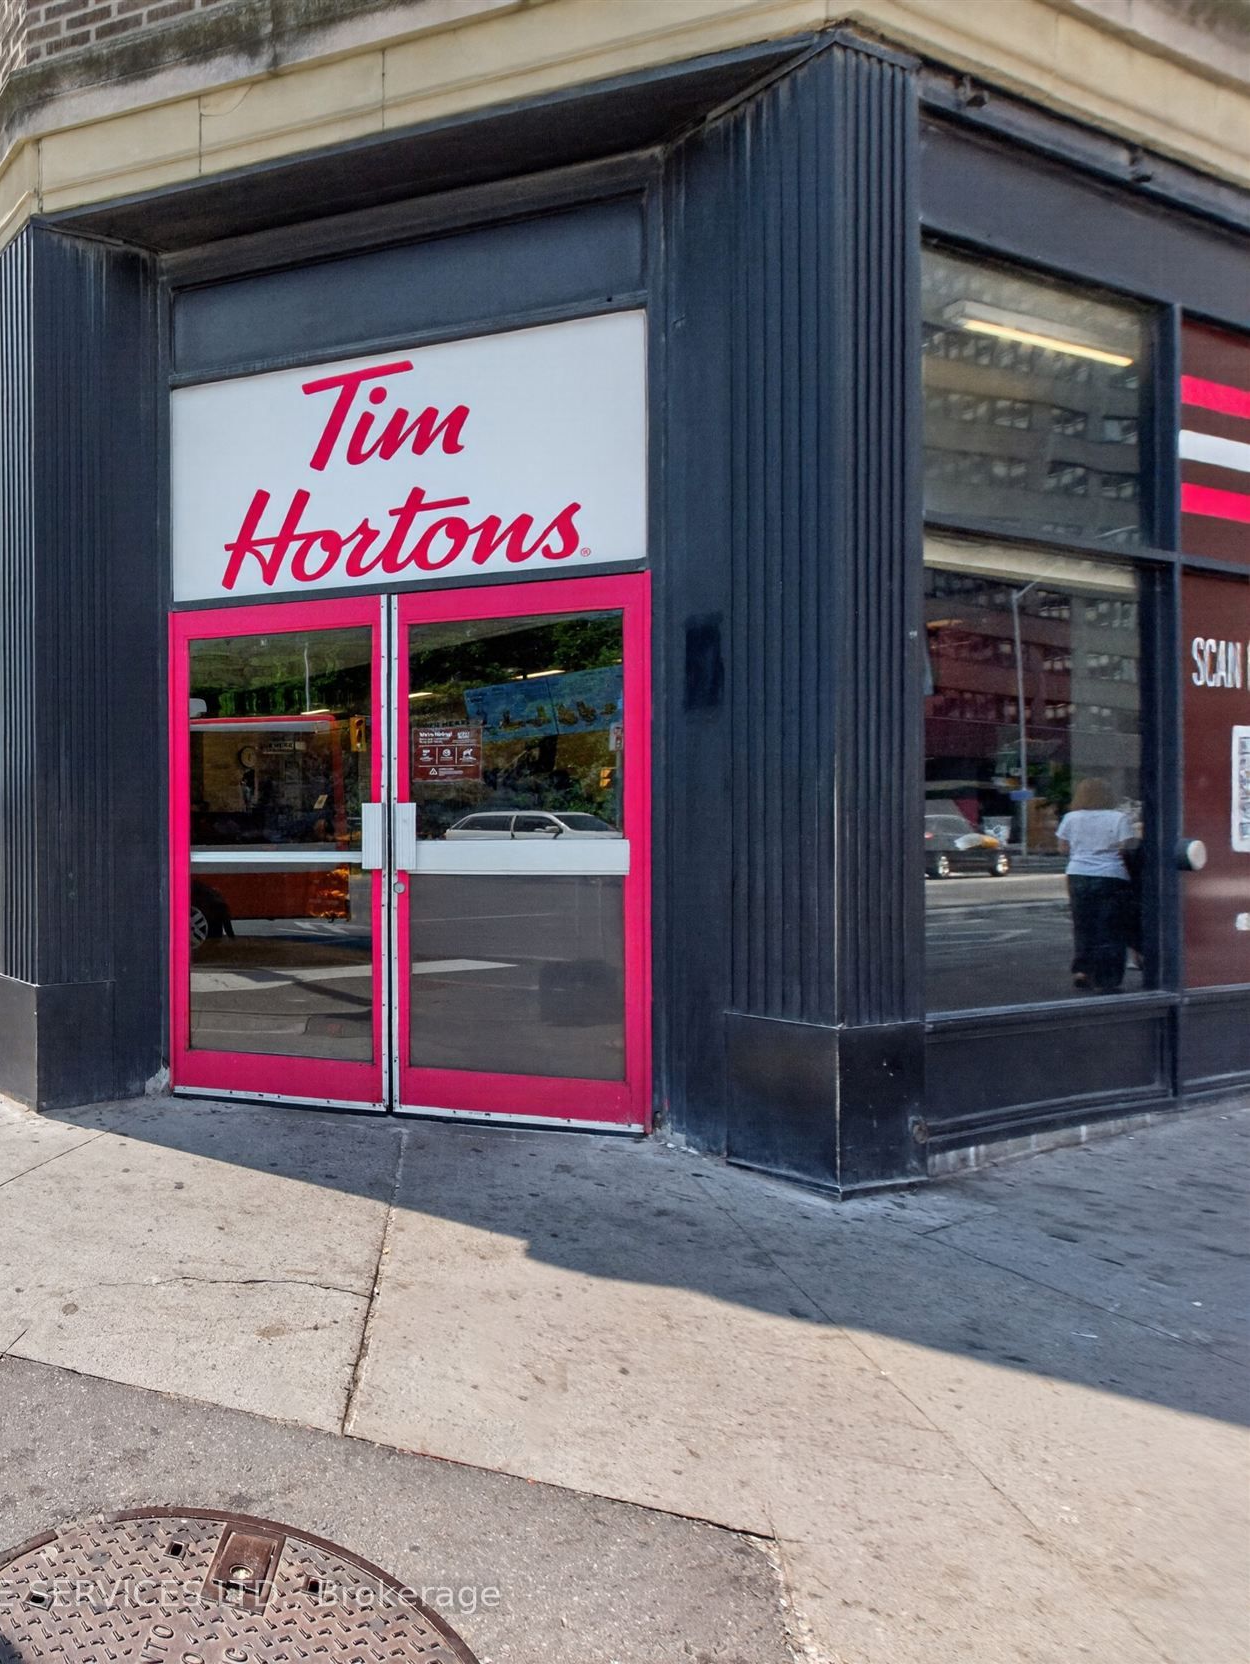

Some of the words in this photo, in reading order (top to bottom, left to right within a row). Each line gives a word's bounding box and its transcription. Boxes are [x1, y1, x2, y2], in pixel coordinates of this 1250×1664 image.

[302, 360, 470, 472] Tim
[221, 486, 581, 591] Hortons
[1191, 636, 1242, 689] SCAN
